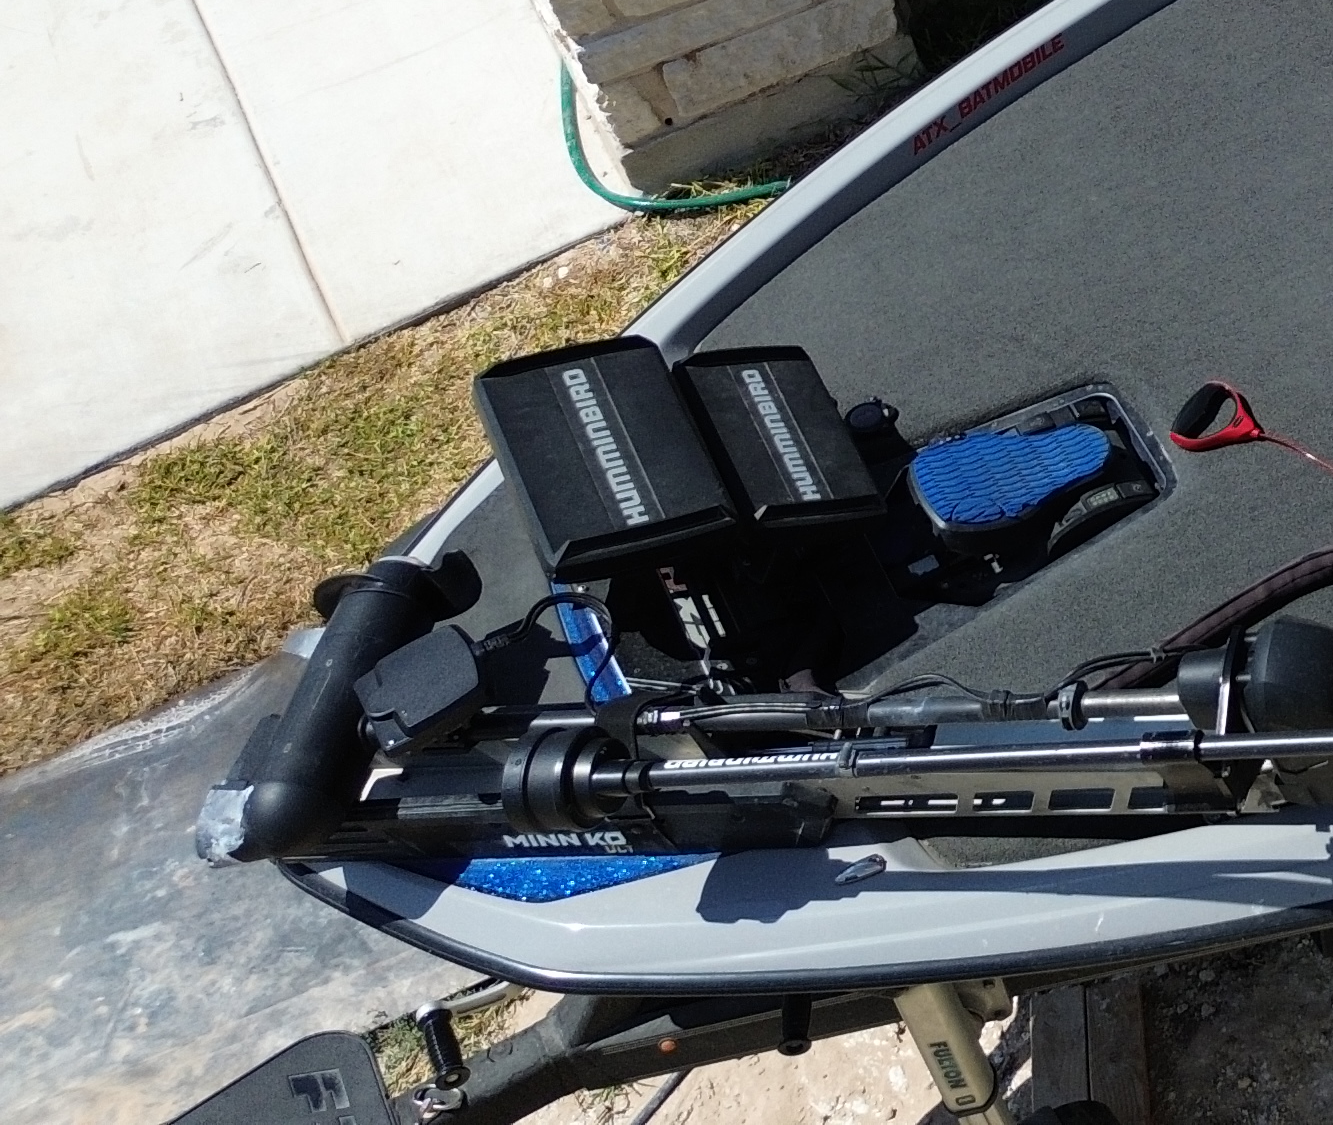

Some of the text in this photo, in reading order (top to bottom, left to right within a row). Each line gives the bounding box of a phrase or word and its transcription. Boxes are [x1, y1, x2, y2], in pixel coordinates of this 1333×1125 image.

[912, 32, 1065, 156] ATX_BATMOBILE
[562, 368, 650, 526] HUMMINBIRD
[742, 368, 822, 502] HUMMINBIRD
[502, 830, 628, 848] MINN KO
[928, 1041, 968, 1090] FULTON
